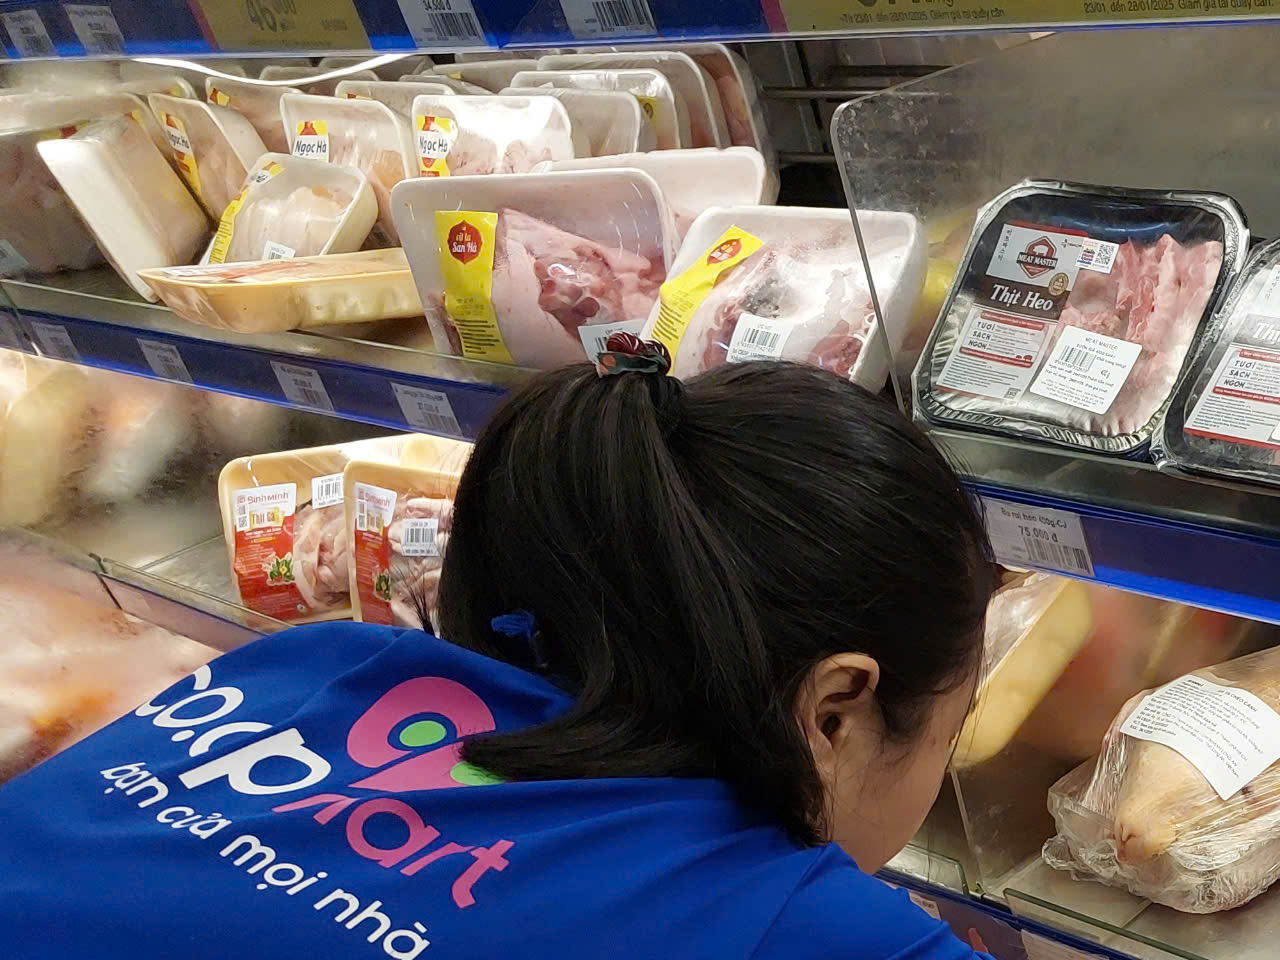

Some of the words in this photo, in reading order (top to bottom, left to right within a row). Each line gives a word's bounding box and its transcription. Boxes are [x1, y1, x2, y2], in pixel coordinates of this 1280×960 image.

[295, 141, 315, 157] Ngọc
[317, 140, 327, 153] Hà
[1017, 254, 1036, 263] MEAT
[1035, 256, 1057, 267] MASTER
[990, 284, 1021, 308] Thịt
[1022, 291, 1054, 312] Heo
[1018, 525, 1049, 541] 75.000
[100, 761, 168, 808] bạn
[156, 804, 233, 840] của
[220, 832, 328, 897] mọi
